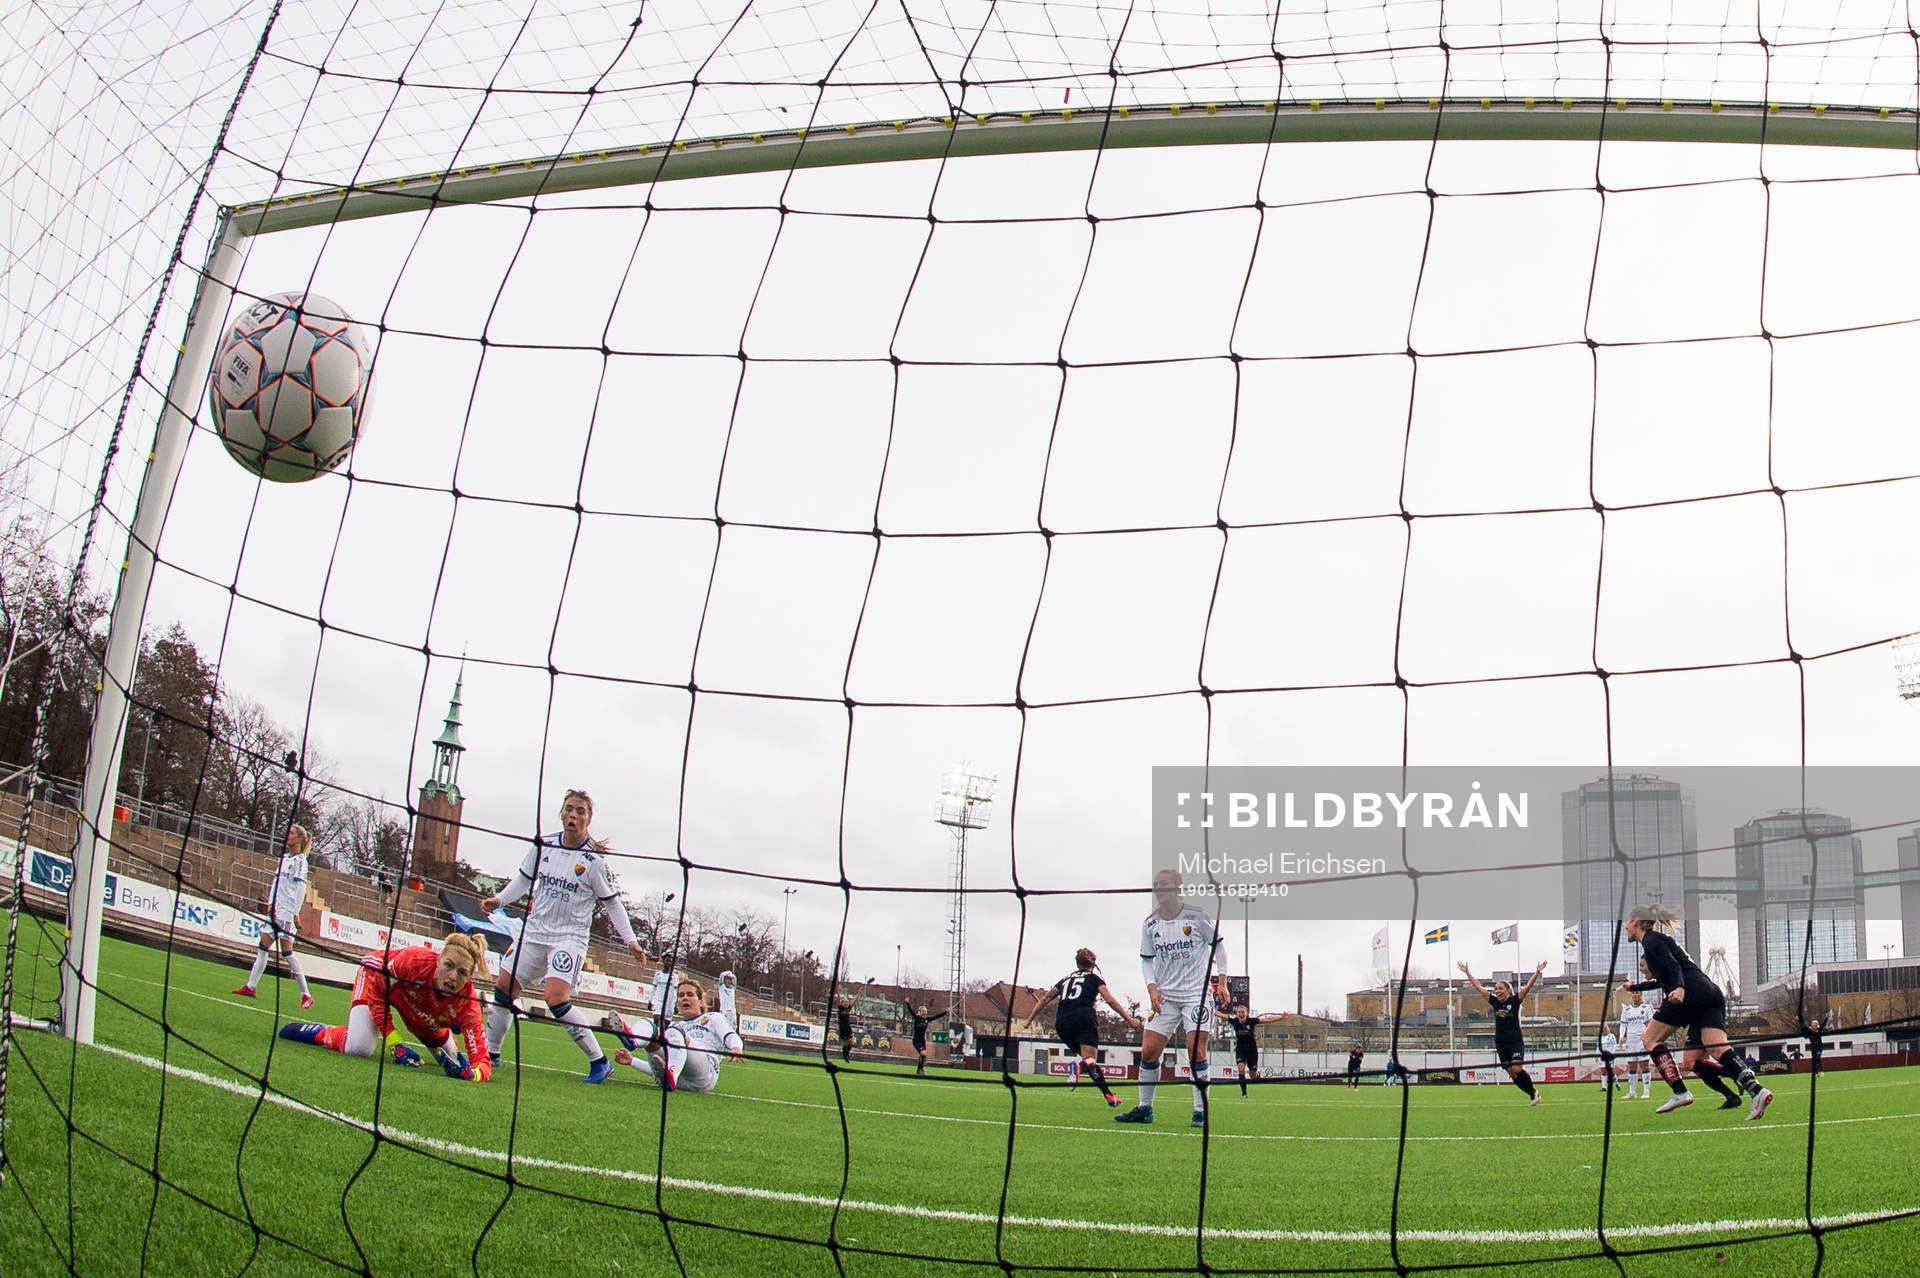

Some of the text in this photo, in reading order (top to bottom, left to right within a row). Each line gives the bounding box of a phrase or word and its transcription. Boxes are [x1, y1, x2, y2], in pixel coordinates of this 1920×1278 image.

[232, 354, 250, 376] FIFA
[121, 887, 160, 913] Bank
[175, 900, 218, 926] SKF
[1154, 939, 1195, 953] Prioritet
[1061, 977, 1086, 1000] 15
